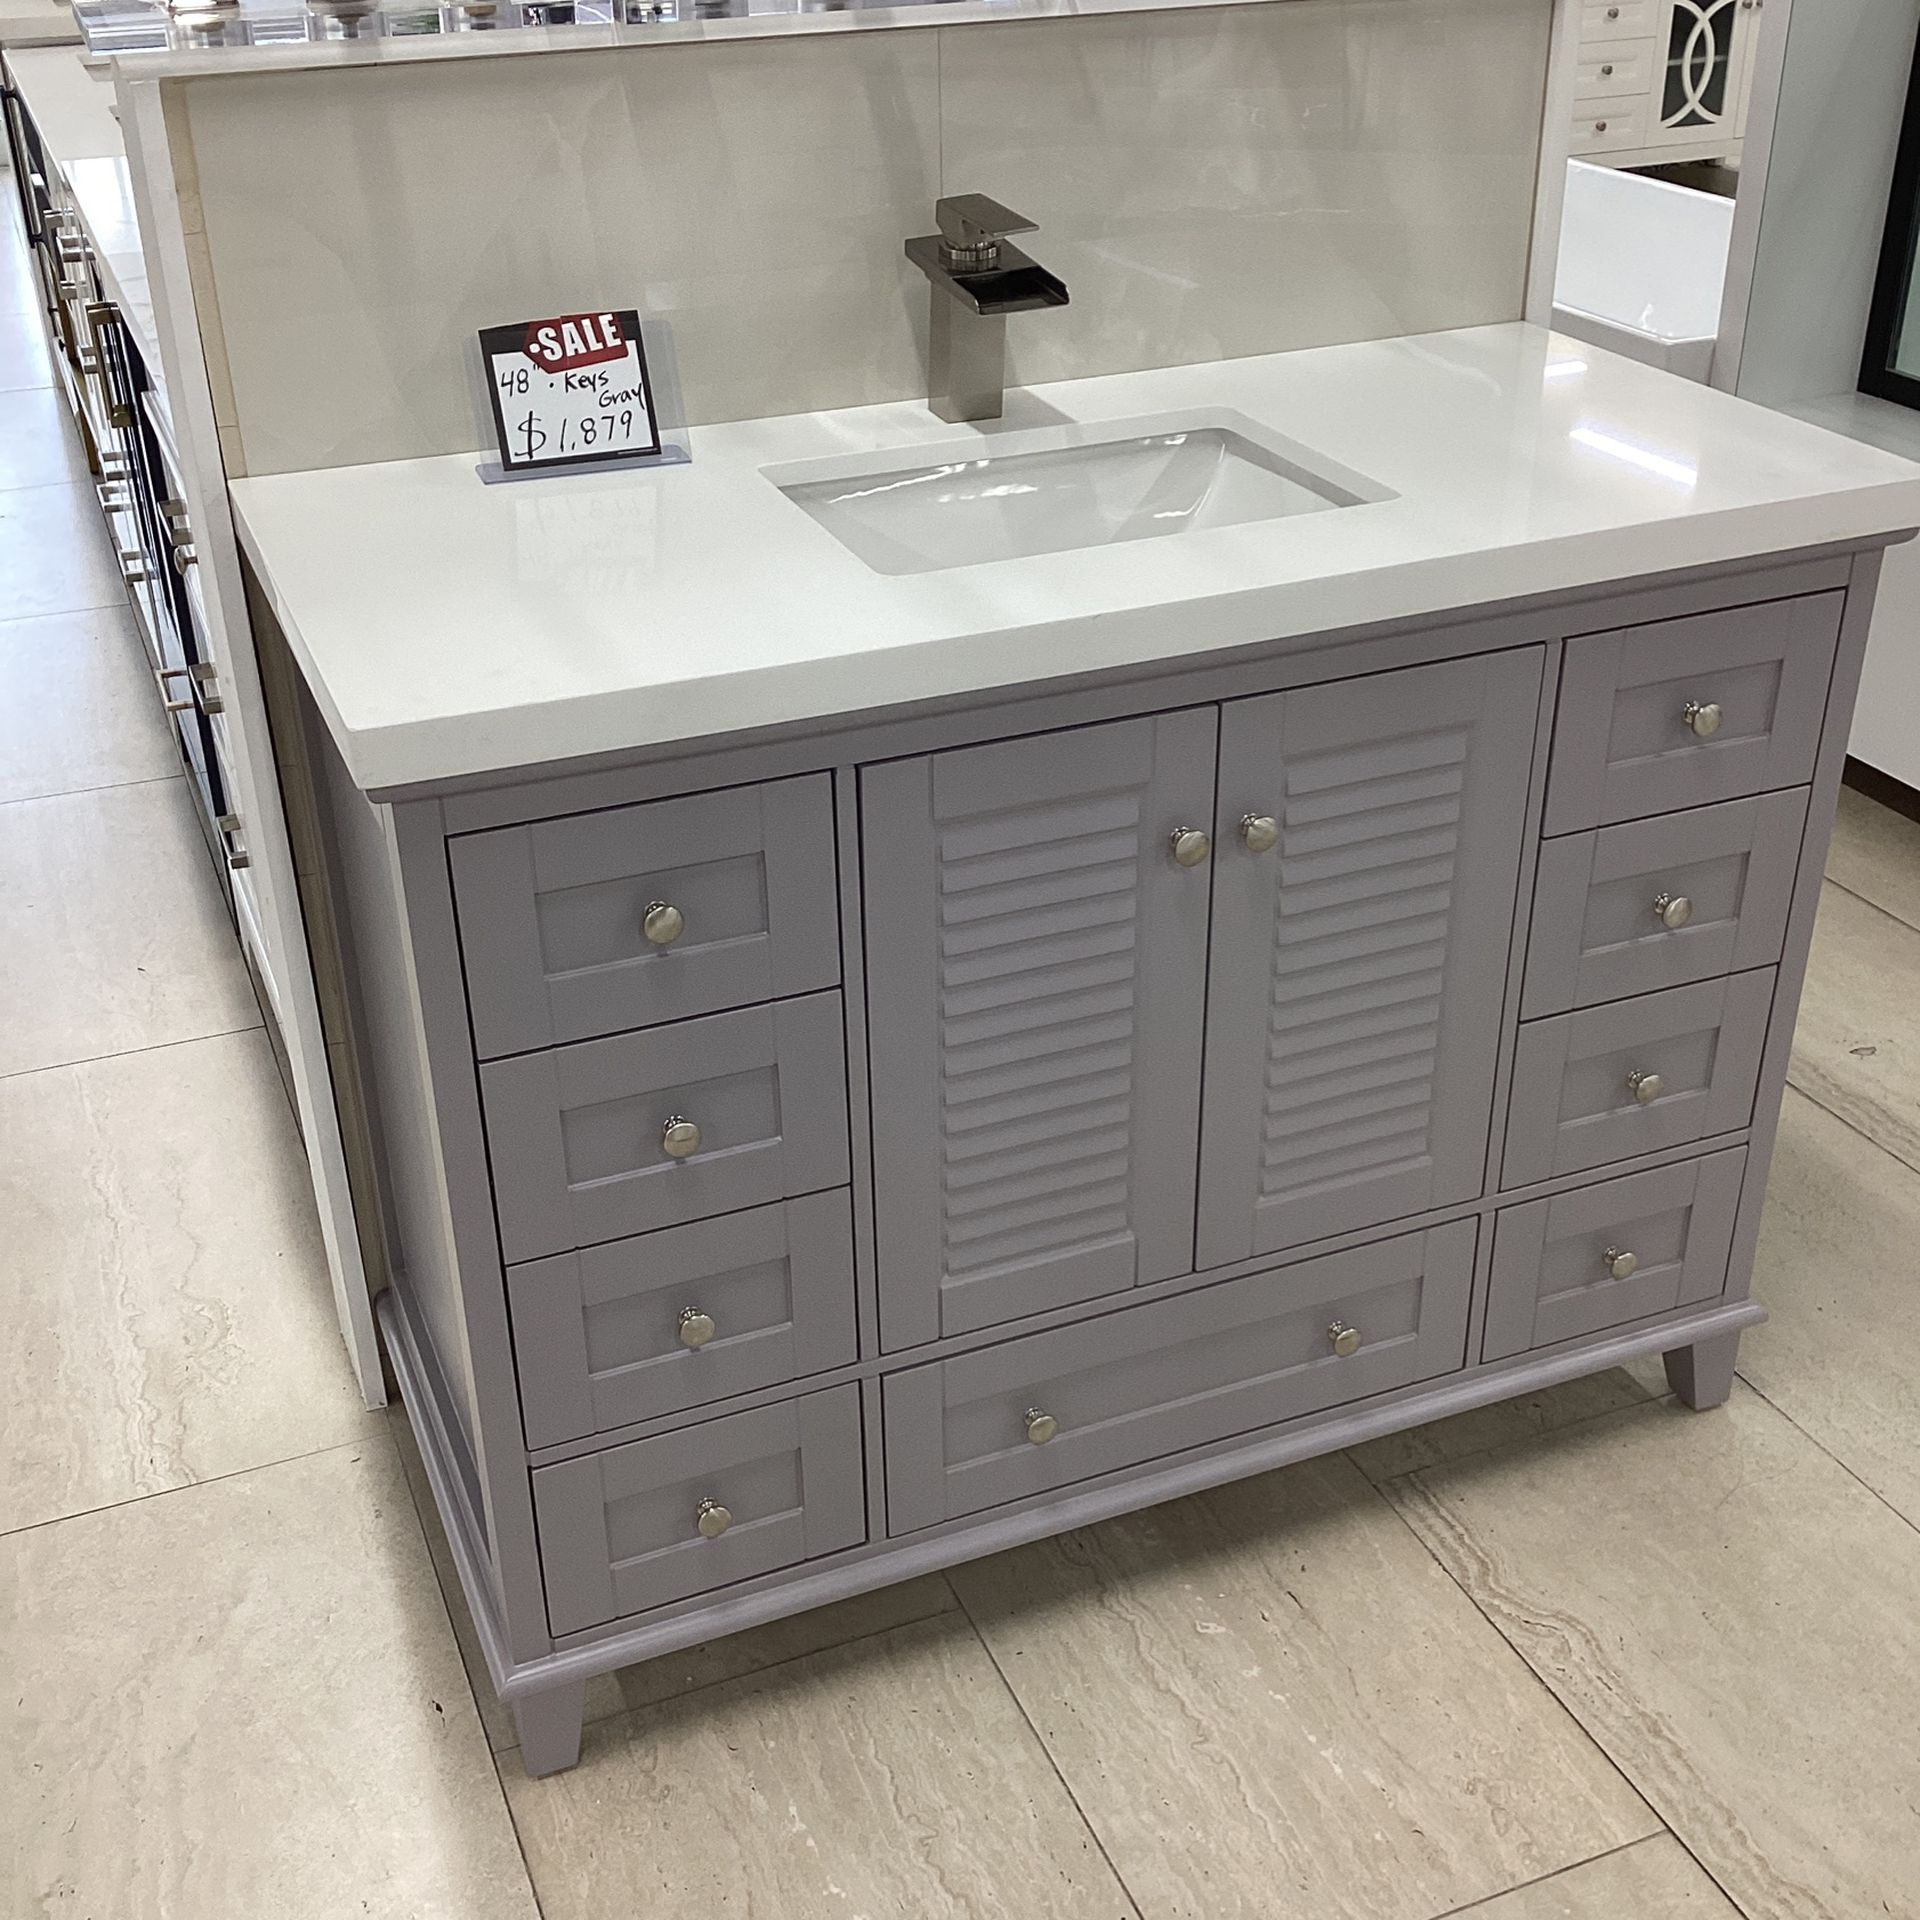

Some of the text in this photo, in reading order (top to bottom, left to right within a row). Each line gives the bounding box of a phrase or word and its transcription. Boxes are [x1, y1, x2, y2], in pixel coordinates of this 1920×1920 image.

[537, 313, 622, 361] SALE
[565, 370, 609, 393] Keys
[599, 383, 645, 410] Gray
[514, 410, 633, 460] $1,879
